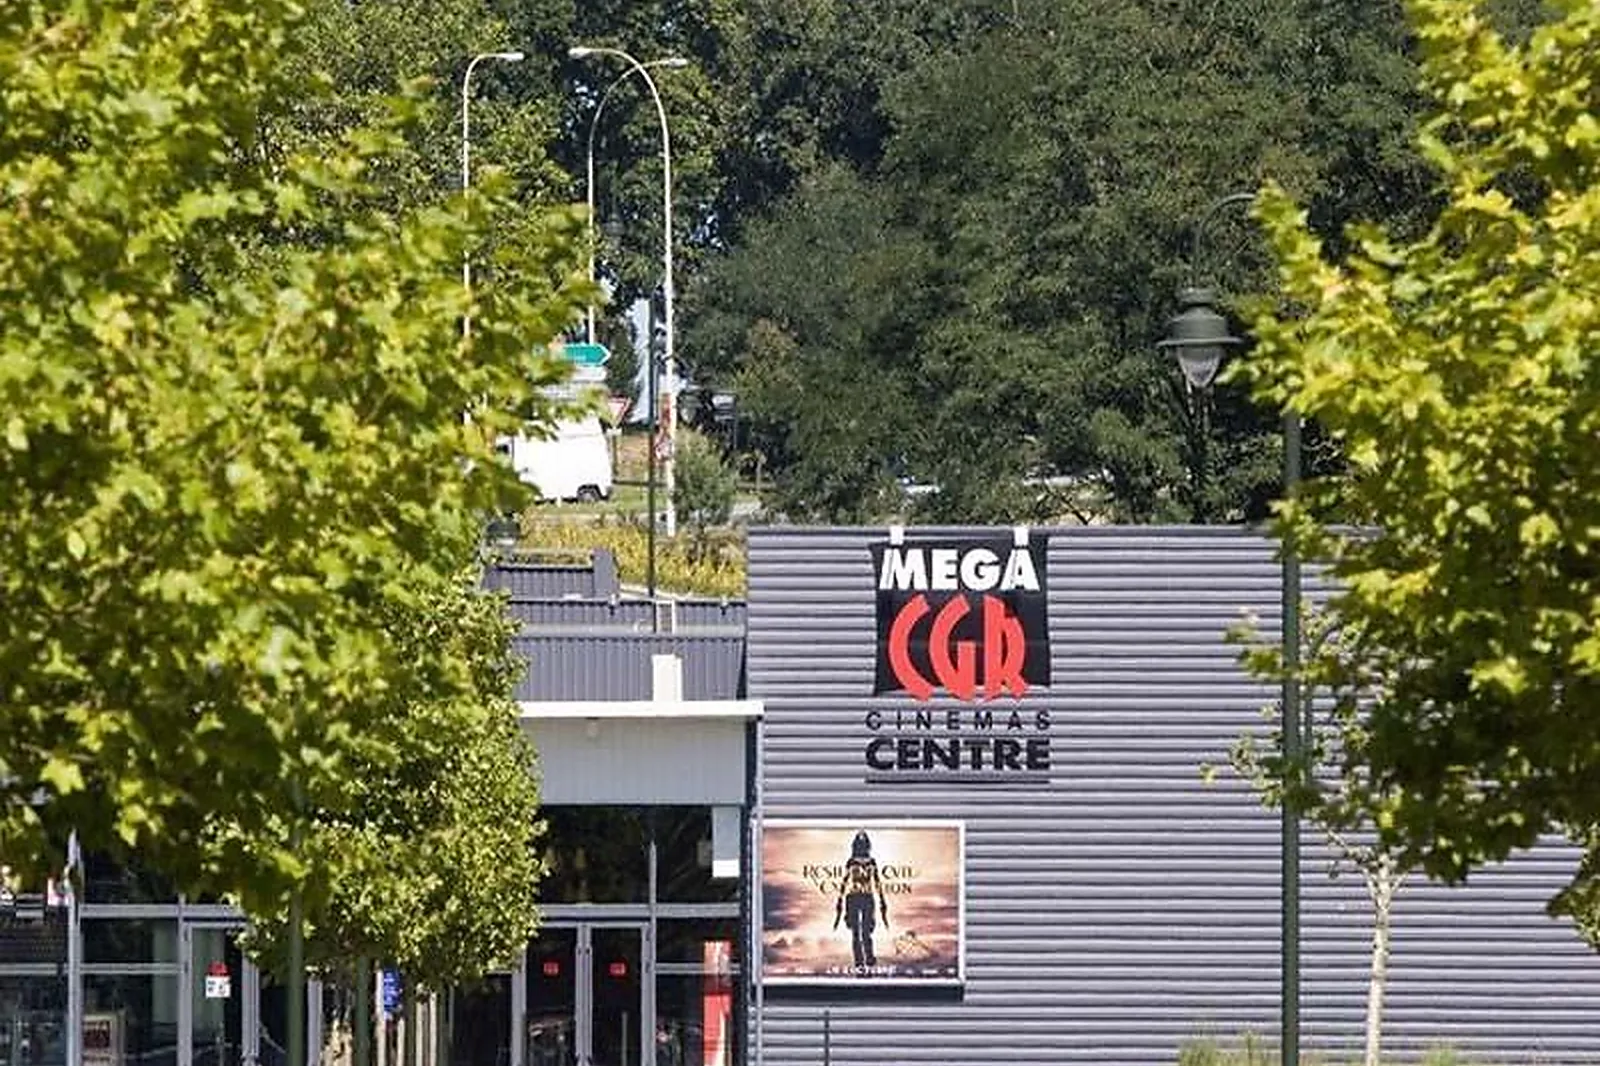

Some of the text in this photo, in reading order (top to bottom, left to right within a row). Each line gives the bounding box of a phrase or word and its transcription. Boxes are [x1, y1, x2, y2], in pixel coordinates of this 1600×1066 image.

[879, 548, 1040, 591] MEGA
[888, 592, 1028, 702] CGR
[865, 710, 1051, 731] CINEMAS
[865, 738, 1050, 771] CENTRE
